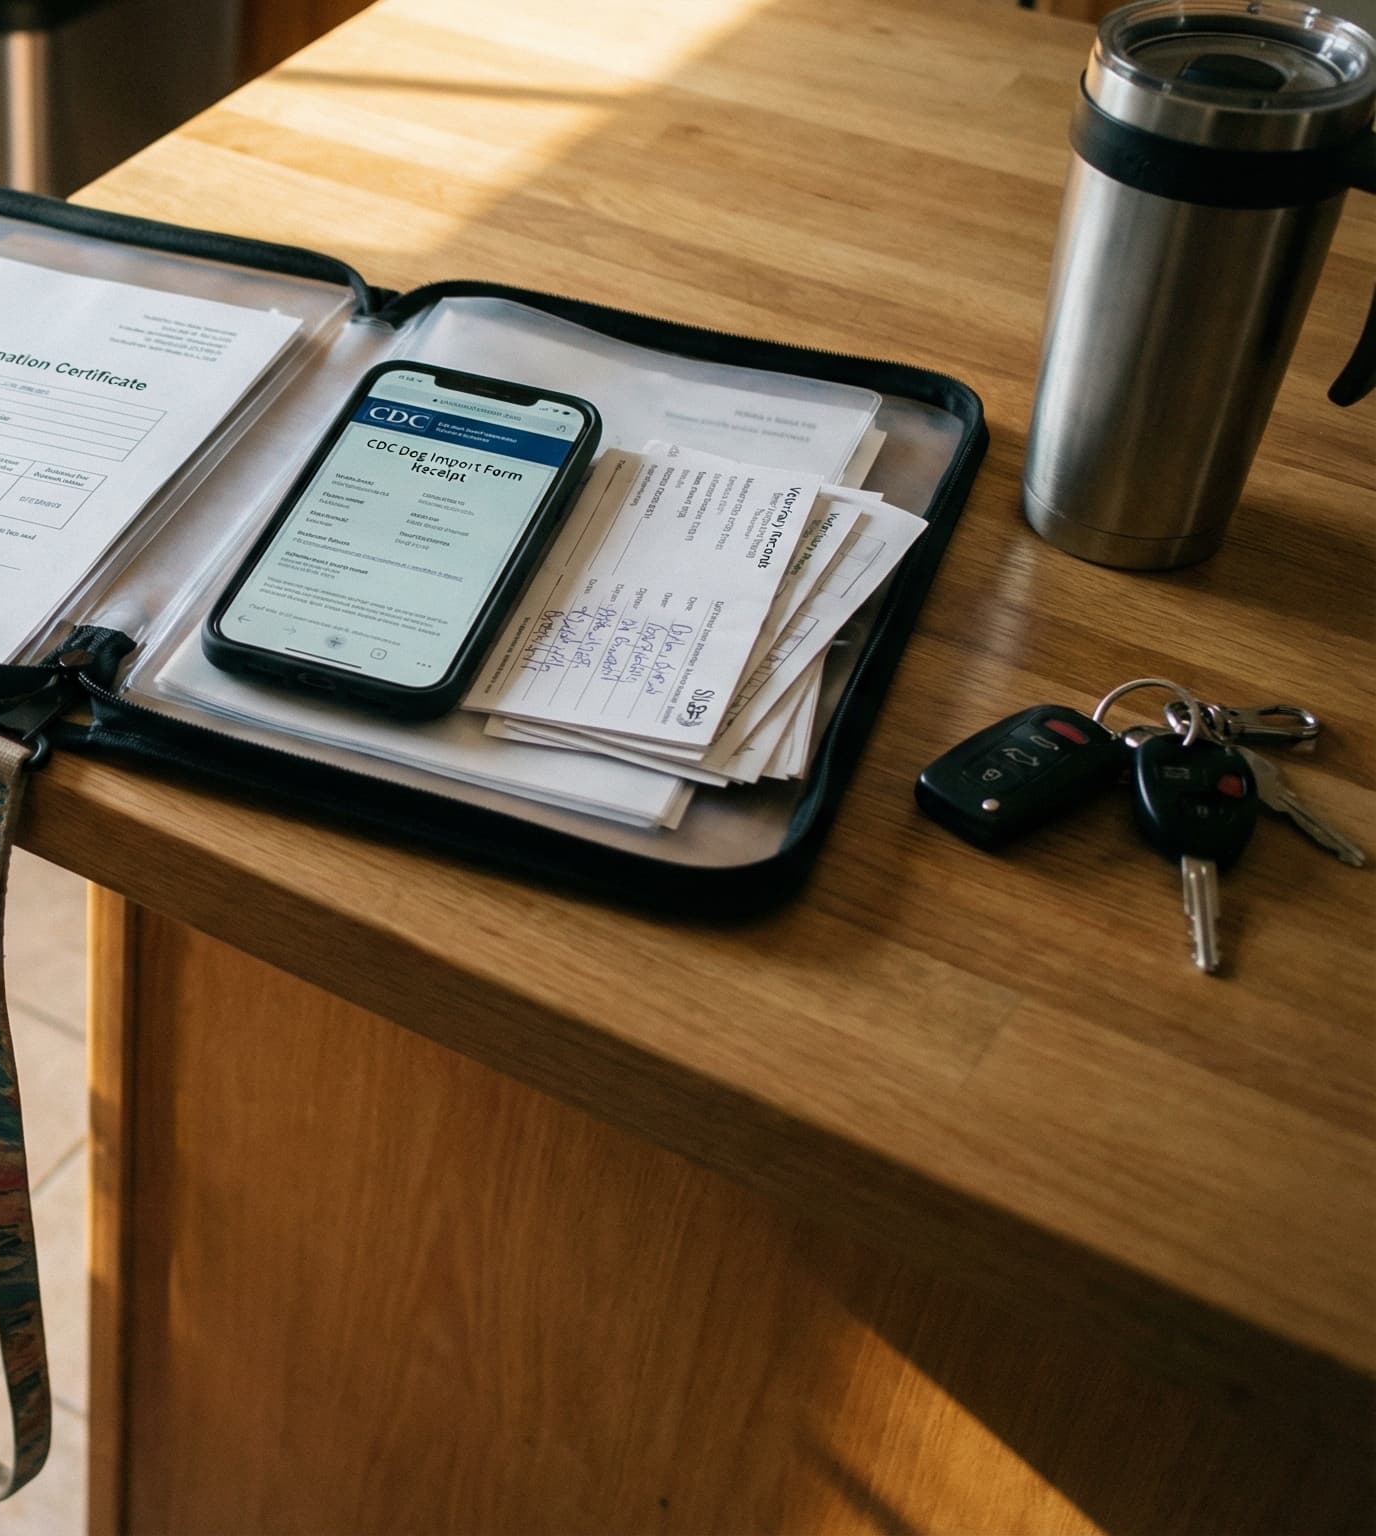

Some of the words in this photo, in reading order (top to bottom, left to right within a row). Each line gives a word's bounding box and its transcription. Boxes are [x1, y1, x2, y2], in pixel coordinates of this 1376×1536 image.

[55, 362, 148, 392] Certificate
[368, 406, 430, 429] CDC
[366, 439, 397, 453] CDC
[398, 445, 428, 462] Dog
[430, 452, 482, 474] Import
[483, 464, 523, 482] Form
